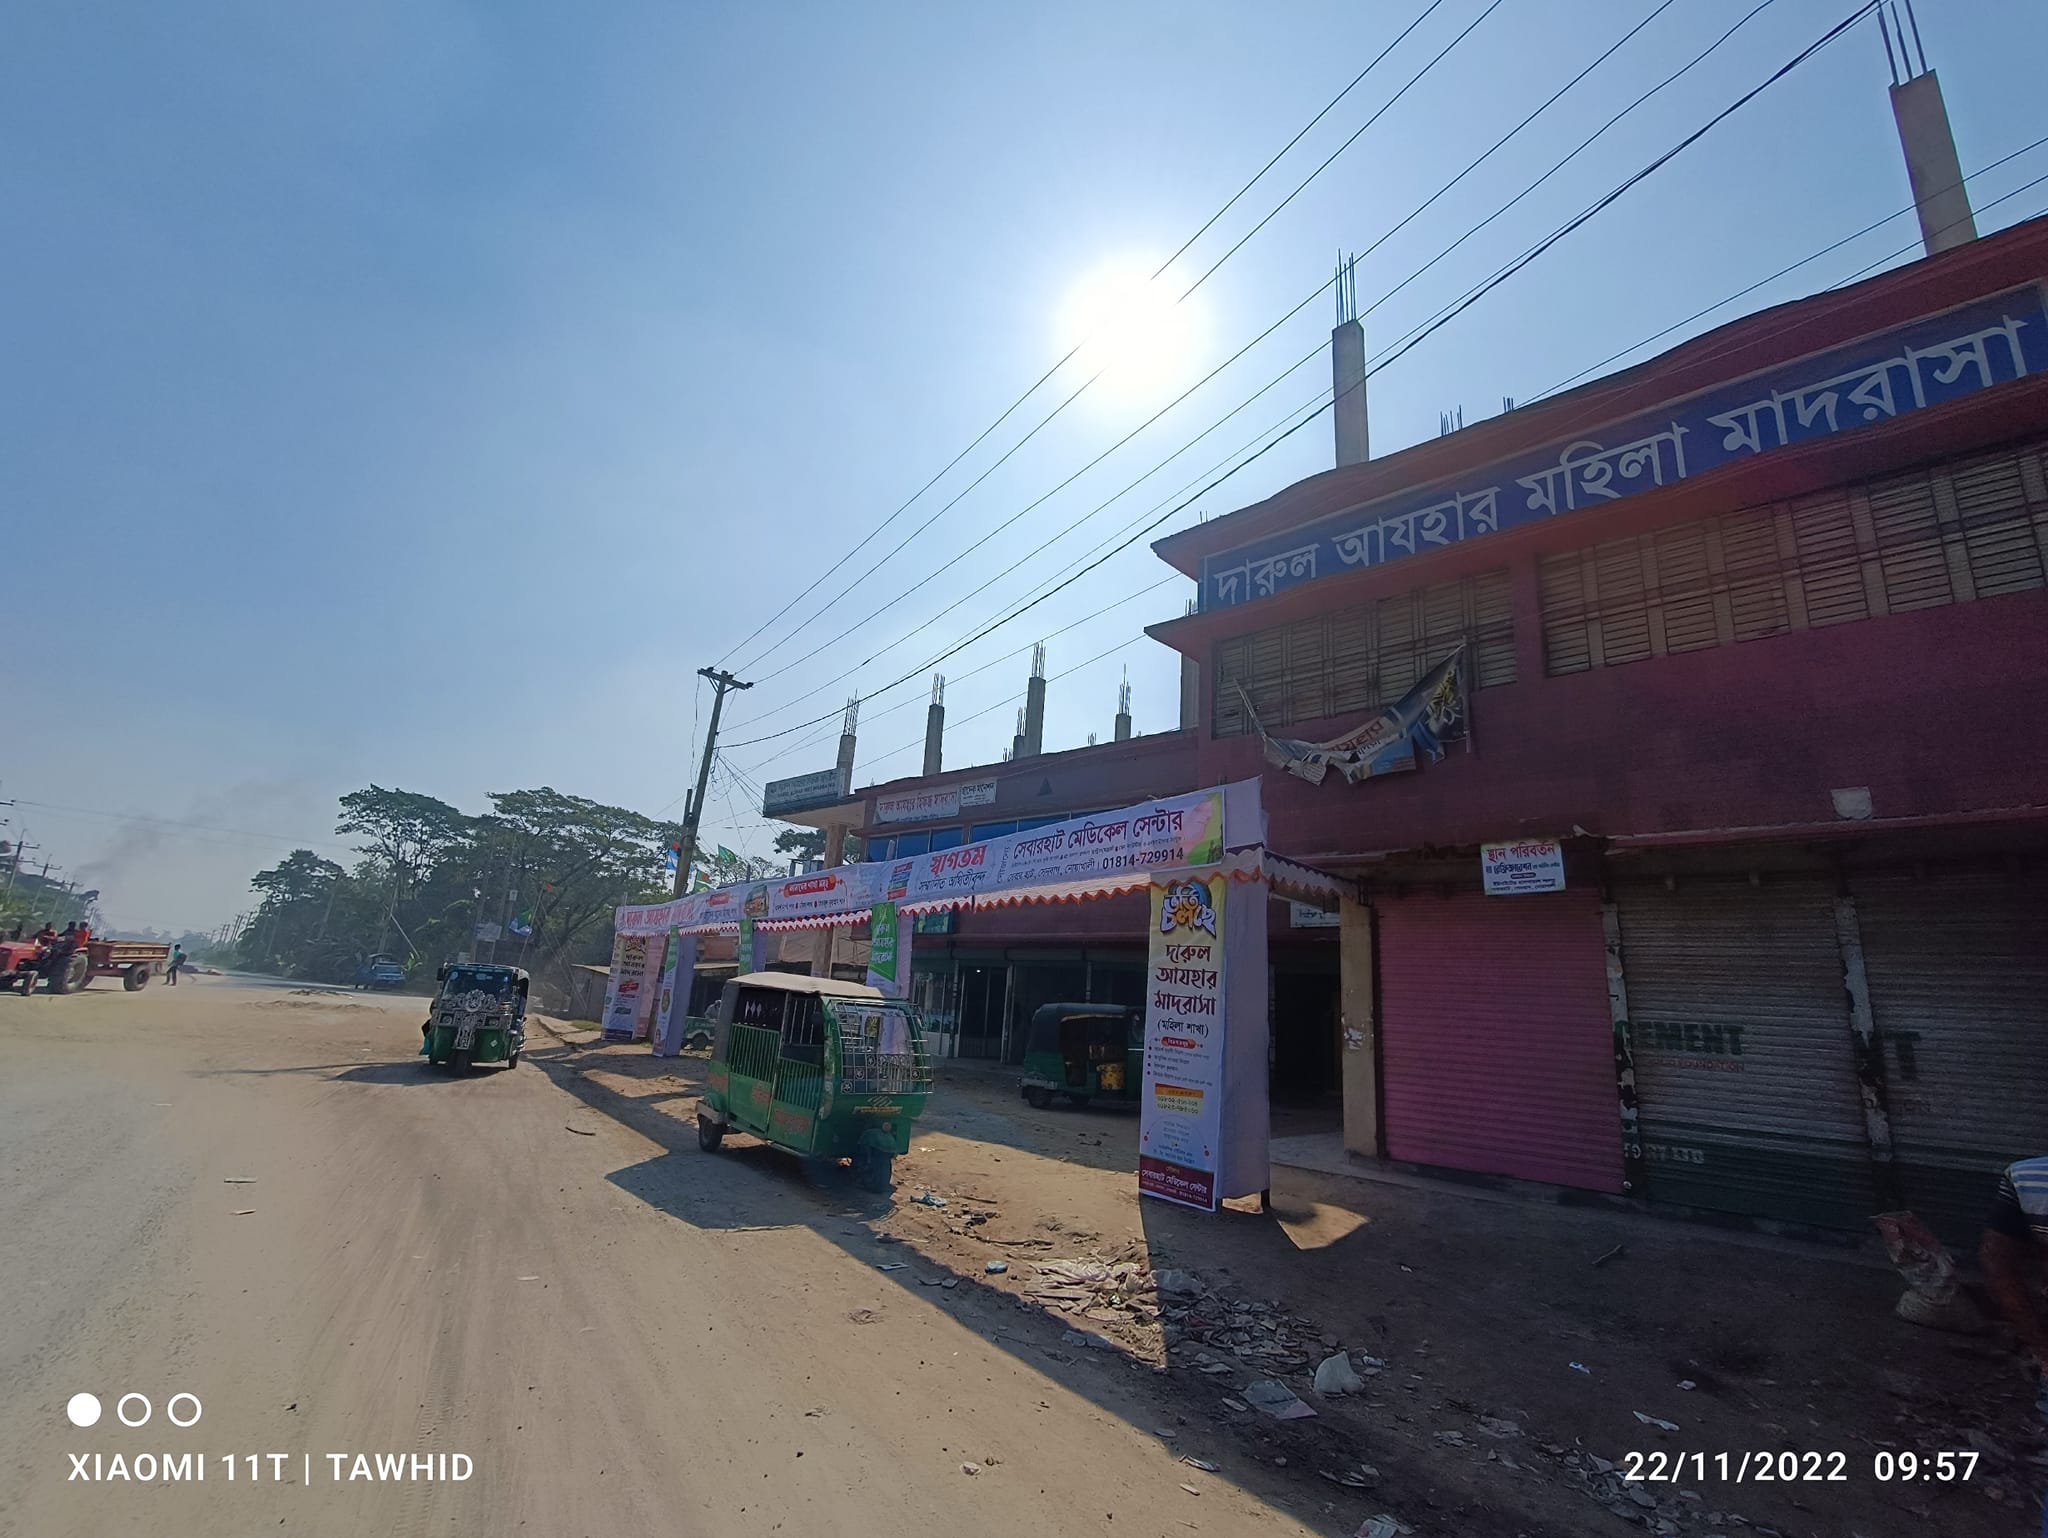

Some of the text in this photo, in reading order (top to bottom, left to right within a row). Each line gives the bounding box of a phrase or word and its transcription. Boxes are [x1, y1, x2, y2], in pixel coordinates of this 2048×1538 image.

[1214, 314, 2029, 604] দারুল আযহার মহিলা মাদরাসা
[1014, 829, 1066, 859] সেবারহাট
[1068, 821, 1129, 849] মেডিকেল
[1133, 807, 1185, 838] সেন্টার
[930, 844, 988, 876] স্বাগতম
[1102, 848, 1185, 869] 01814-729914
[1510, 841, 1556, 859] পরিবর্তন
[1166, 944, 1211, 964] দারুল
[1155, 967, 1218, 990] আযহার
[1154, 990, 1216, 1015] মাদরাসা
